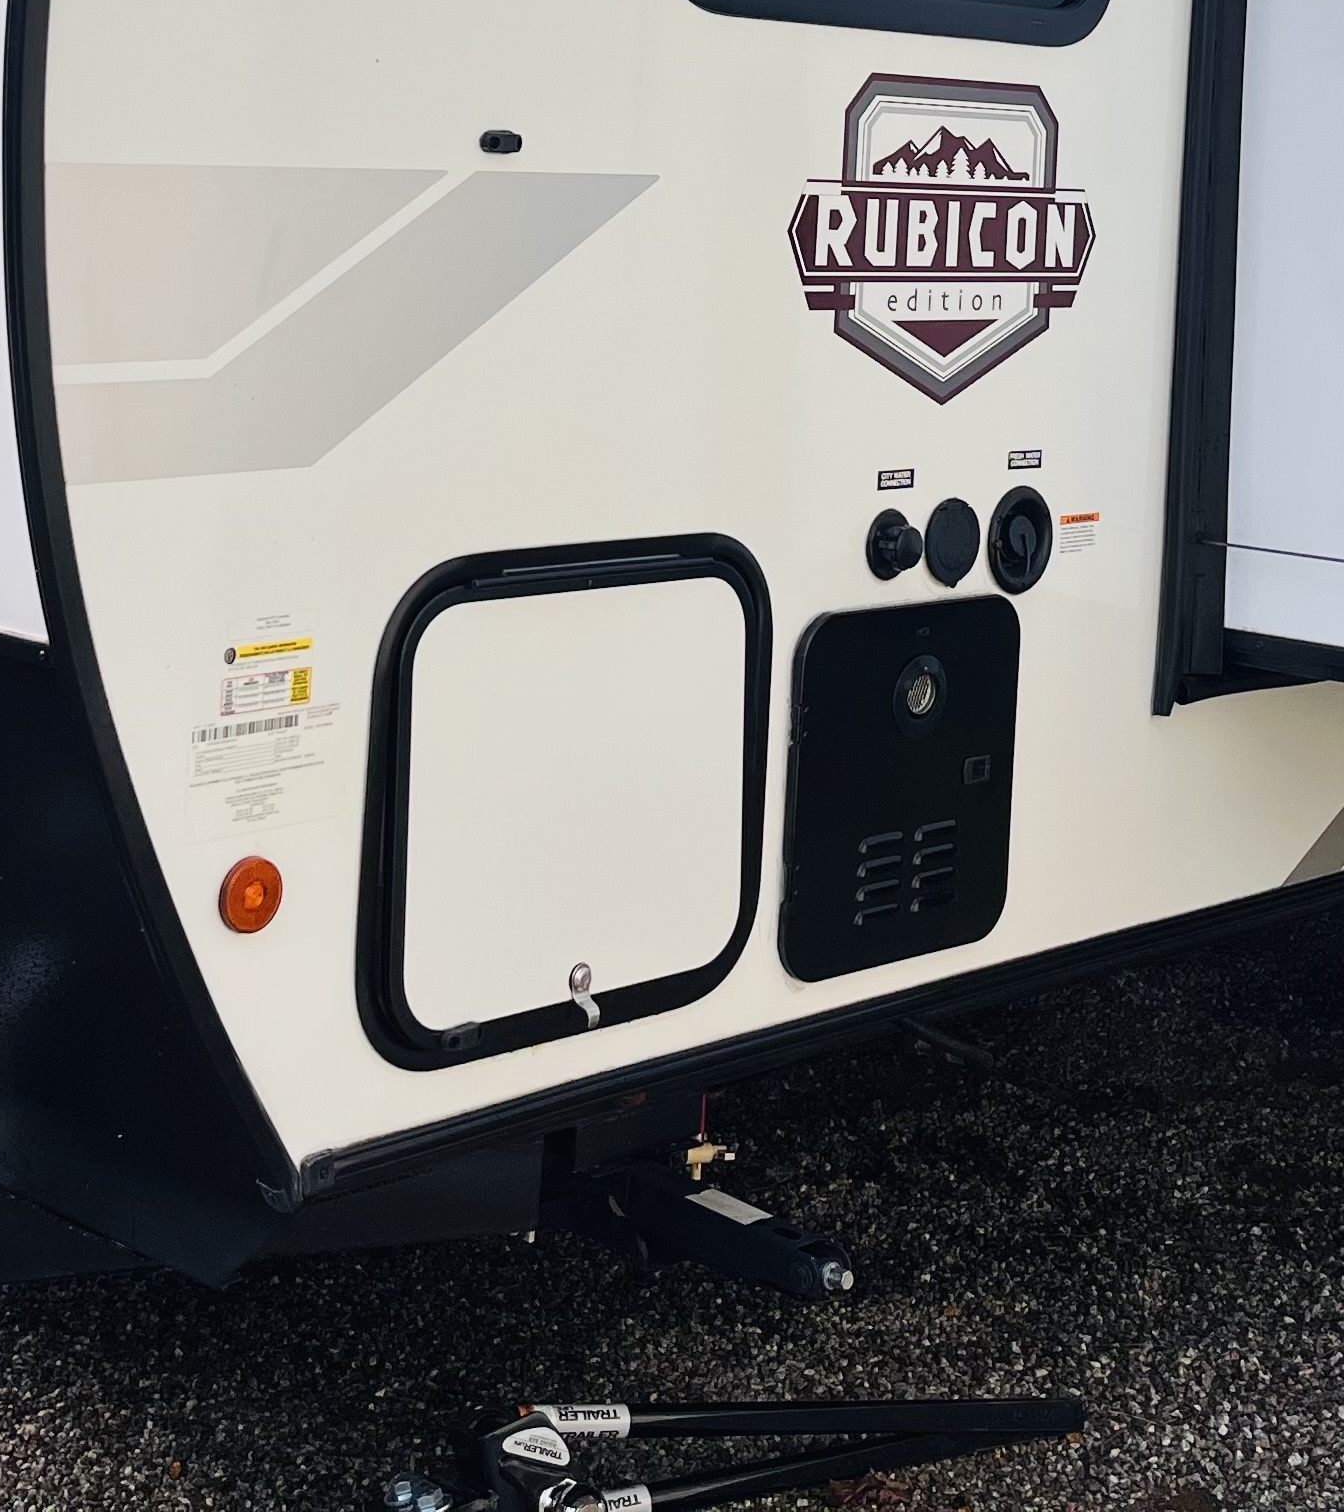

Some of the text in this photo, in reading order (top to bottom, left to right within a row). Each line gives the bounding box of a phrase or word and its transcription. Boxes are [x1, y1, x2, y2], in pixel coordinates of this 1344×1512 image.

[814, 194, 1076, 270] RUBICON
[887, 288, 1002, 312] edition
[558, 1409, 621, 1422] TRAILER
[524, 1444, 563, 1461] TRAILER
[608, 1493, 642, 1510] TRAI
